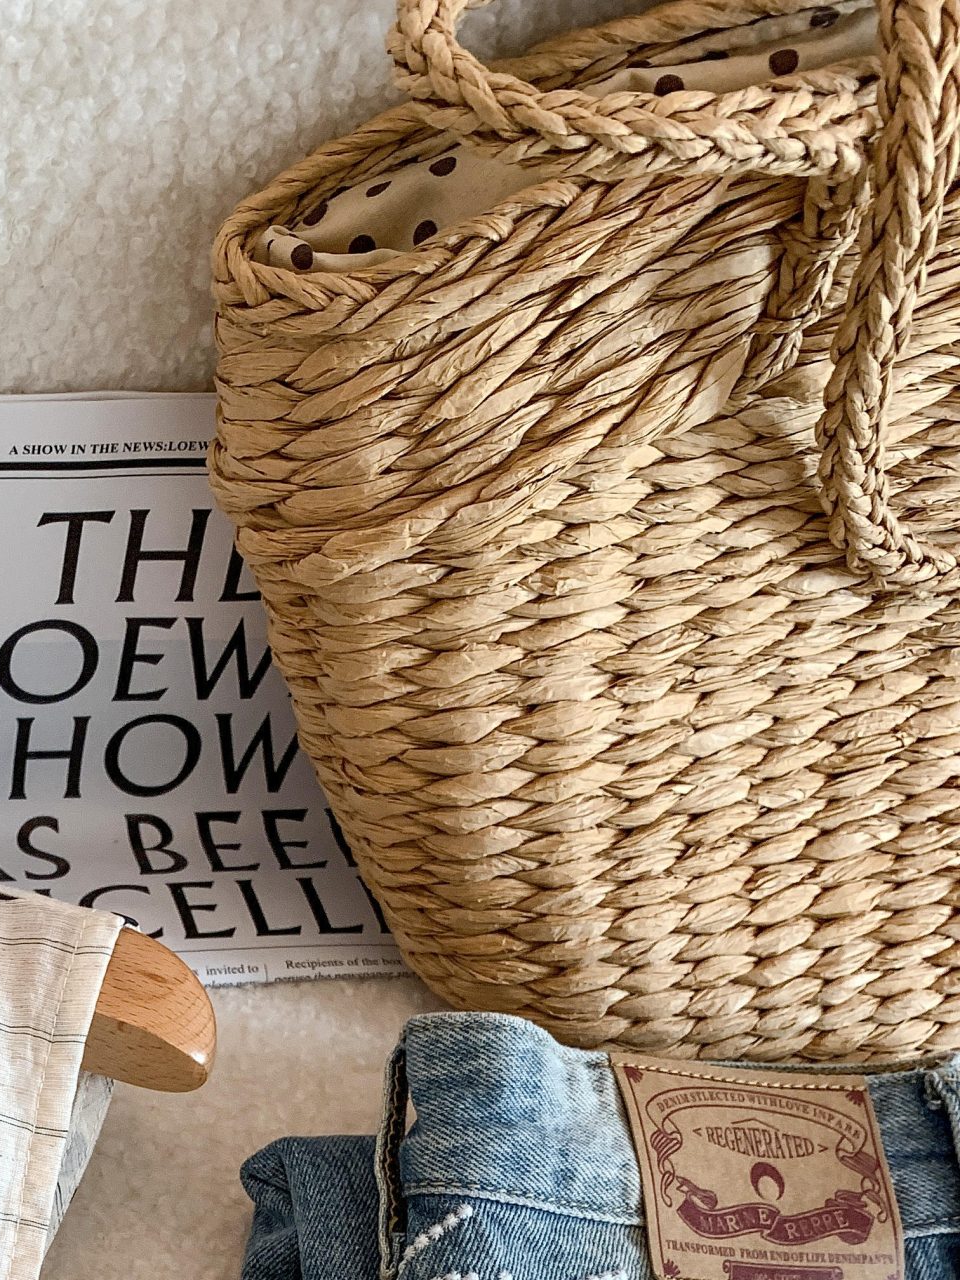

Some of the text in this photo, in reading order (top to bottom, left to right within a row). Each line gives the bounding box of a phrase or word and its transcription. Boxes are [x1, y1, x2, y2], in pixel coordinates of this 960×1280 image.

[9, 445, 19, 455] A
[22, 444, 67, 455] SHOW
[71, 444, 87, 455] IN
[90, 443, 119, 453] THE
[206, 964, 259, 976] invited to
[286, 958, 344, 970] Recipients
[346, 958, 358, 967] of
[361, 957, 379, 966] the
[706, 1126, 814, 1160] REGENERATED
[665, 1239, 736, 1257] TRANSFORMED
